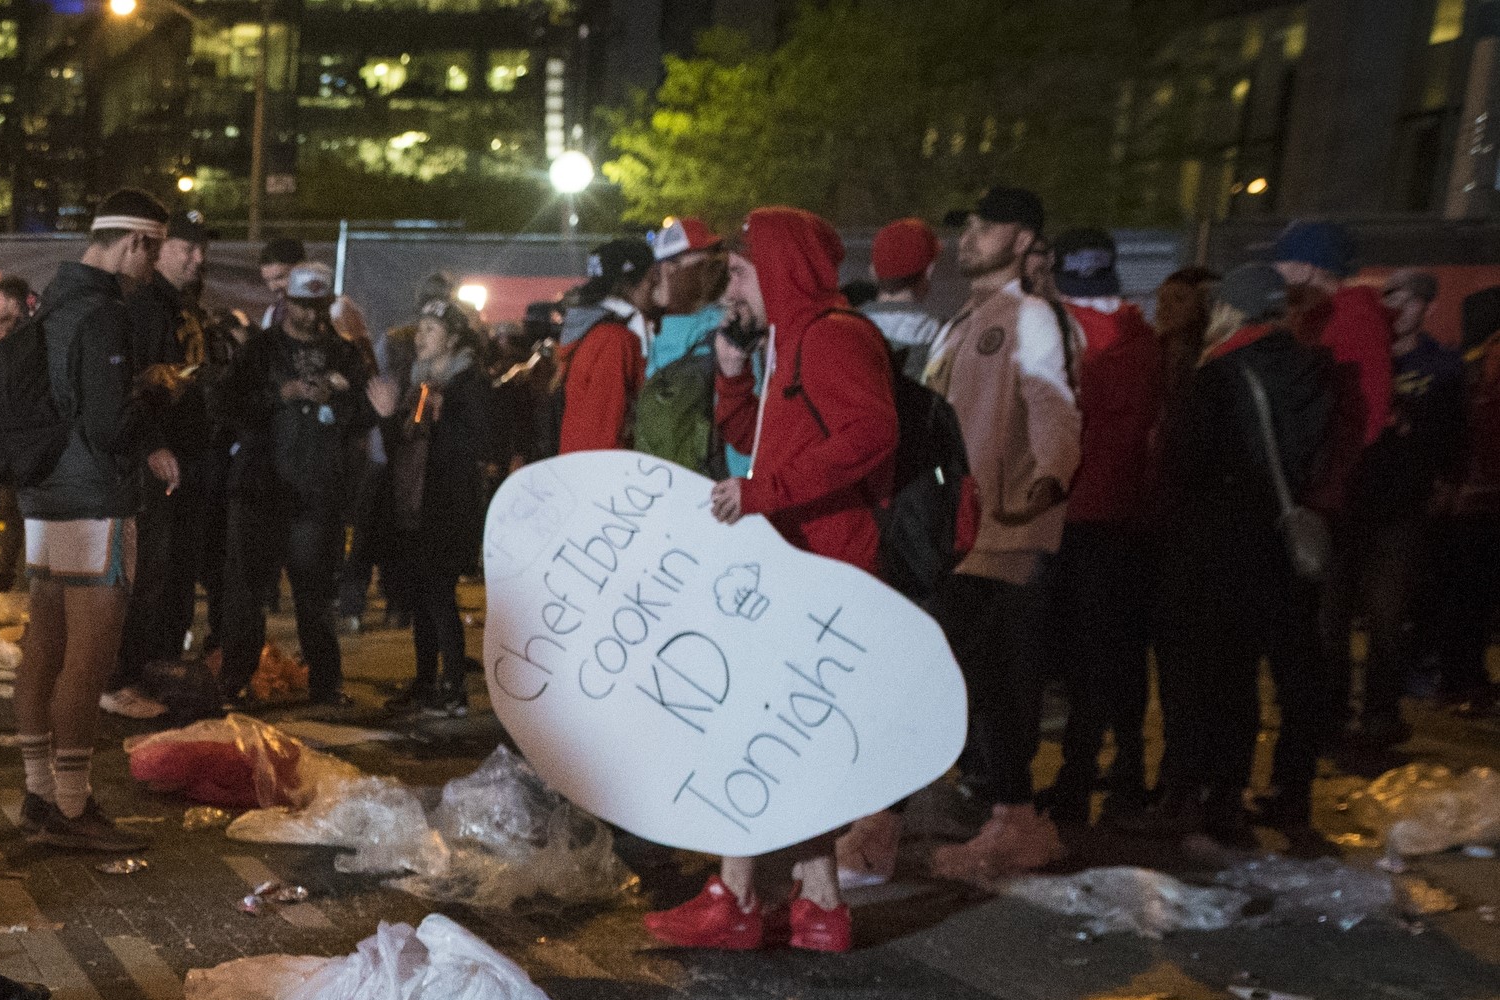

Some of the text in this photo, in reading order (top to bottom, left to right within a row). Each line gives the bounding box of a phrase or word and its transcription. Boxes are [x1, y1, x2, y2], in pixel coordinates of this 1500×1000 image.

[494, 571, 586, 701] Chef
[636, 630, 731, 734] KD
[673, 604, 868, 833] Tonight
